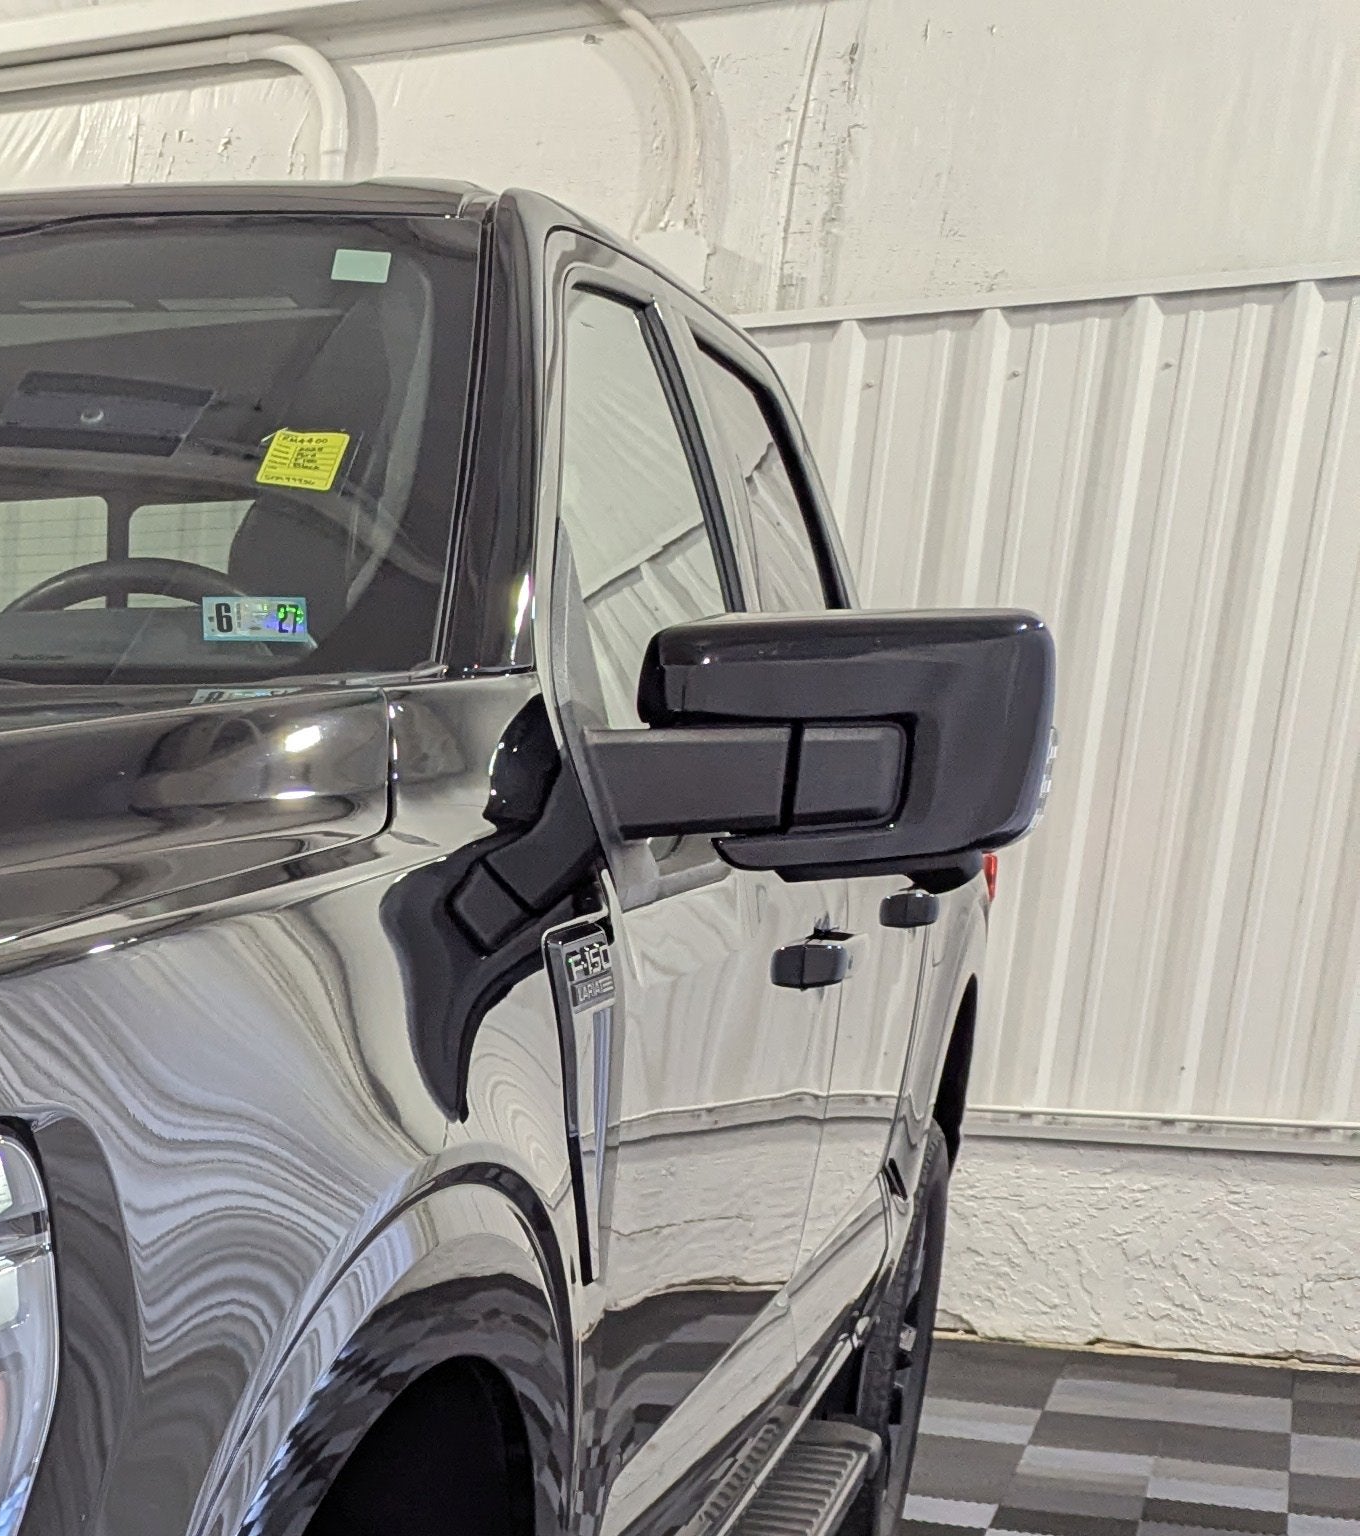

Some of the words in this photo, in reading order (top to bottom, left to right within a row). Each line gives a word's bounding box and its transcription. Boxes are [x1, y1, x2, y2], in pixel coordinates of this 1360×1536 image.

[215, 602, 233, 633] 6
[277, 603, 300, 634] 27
[568, 944, 613, 981] F-150
